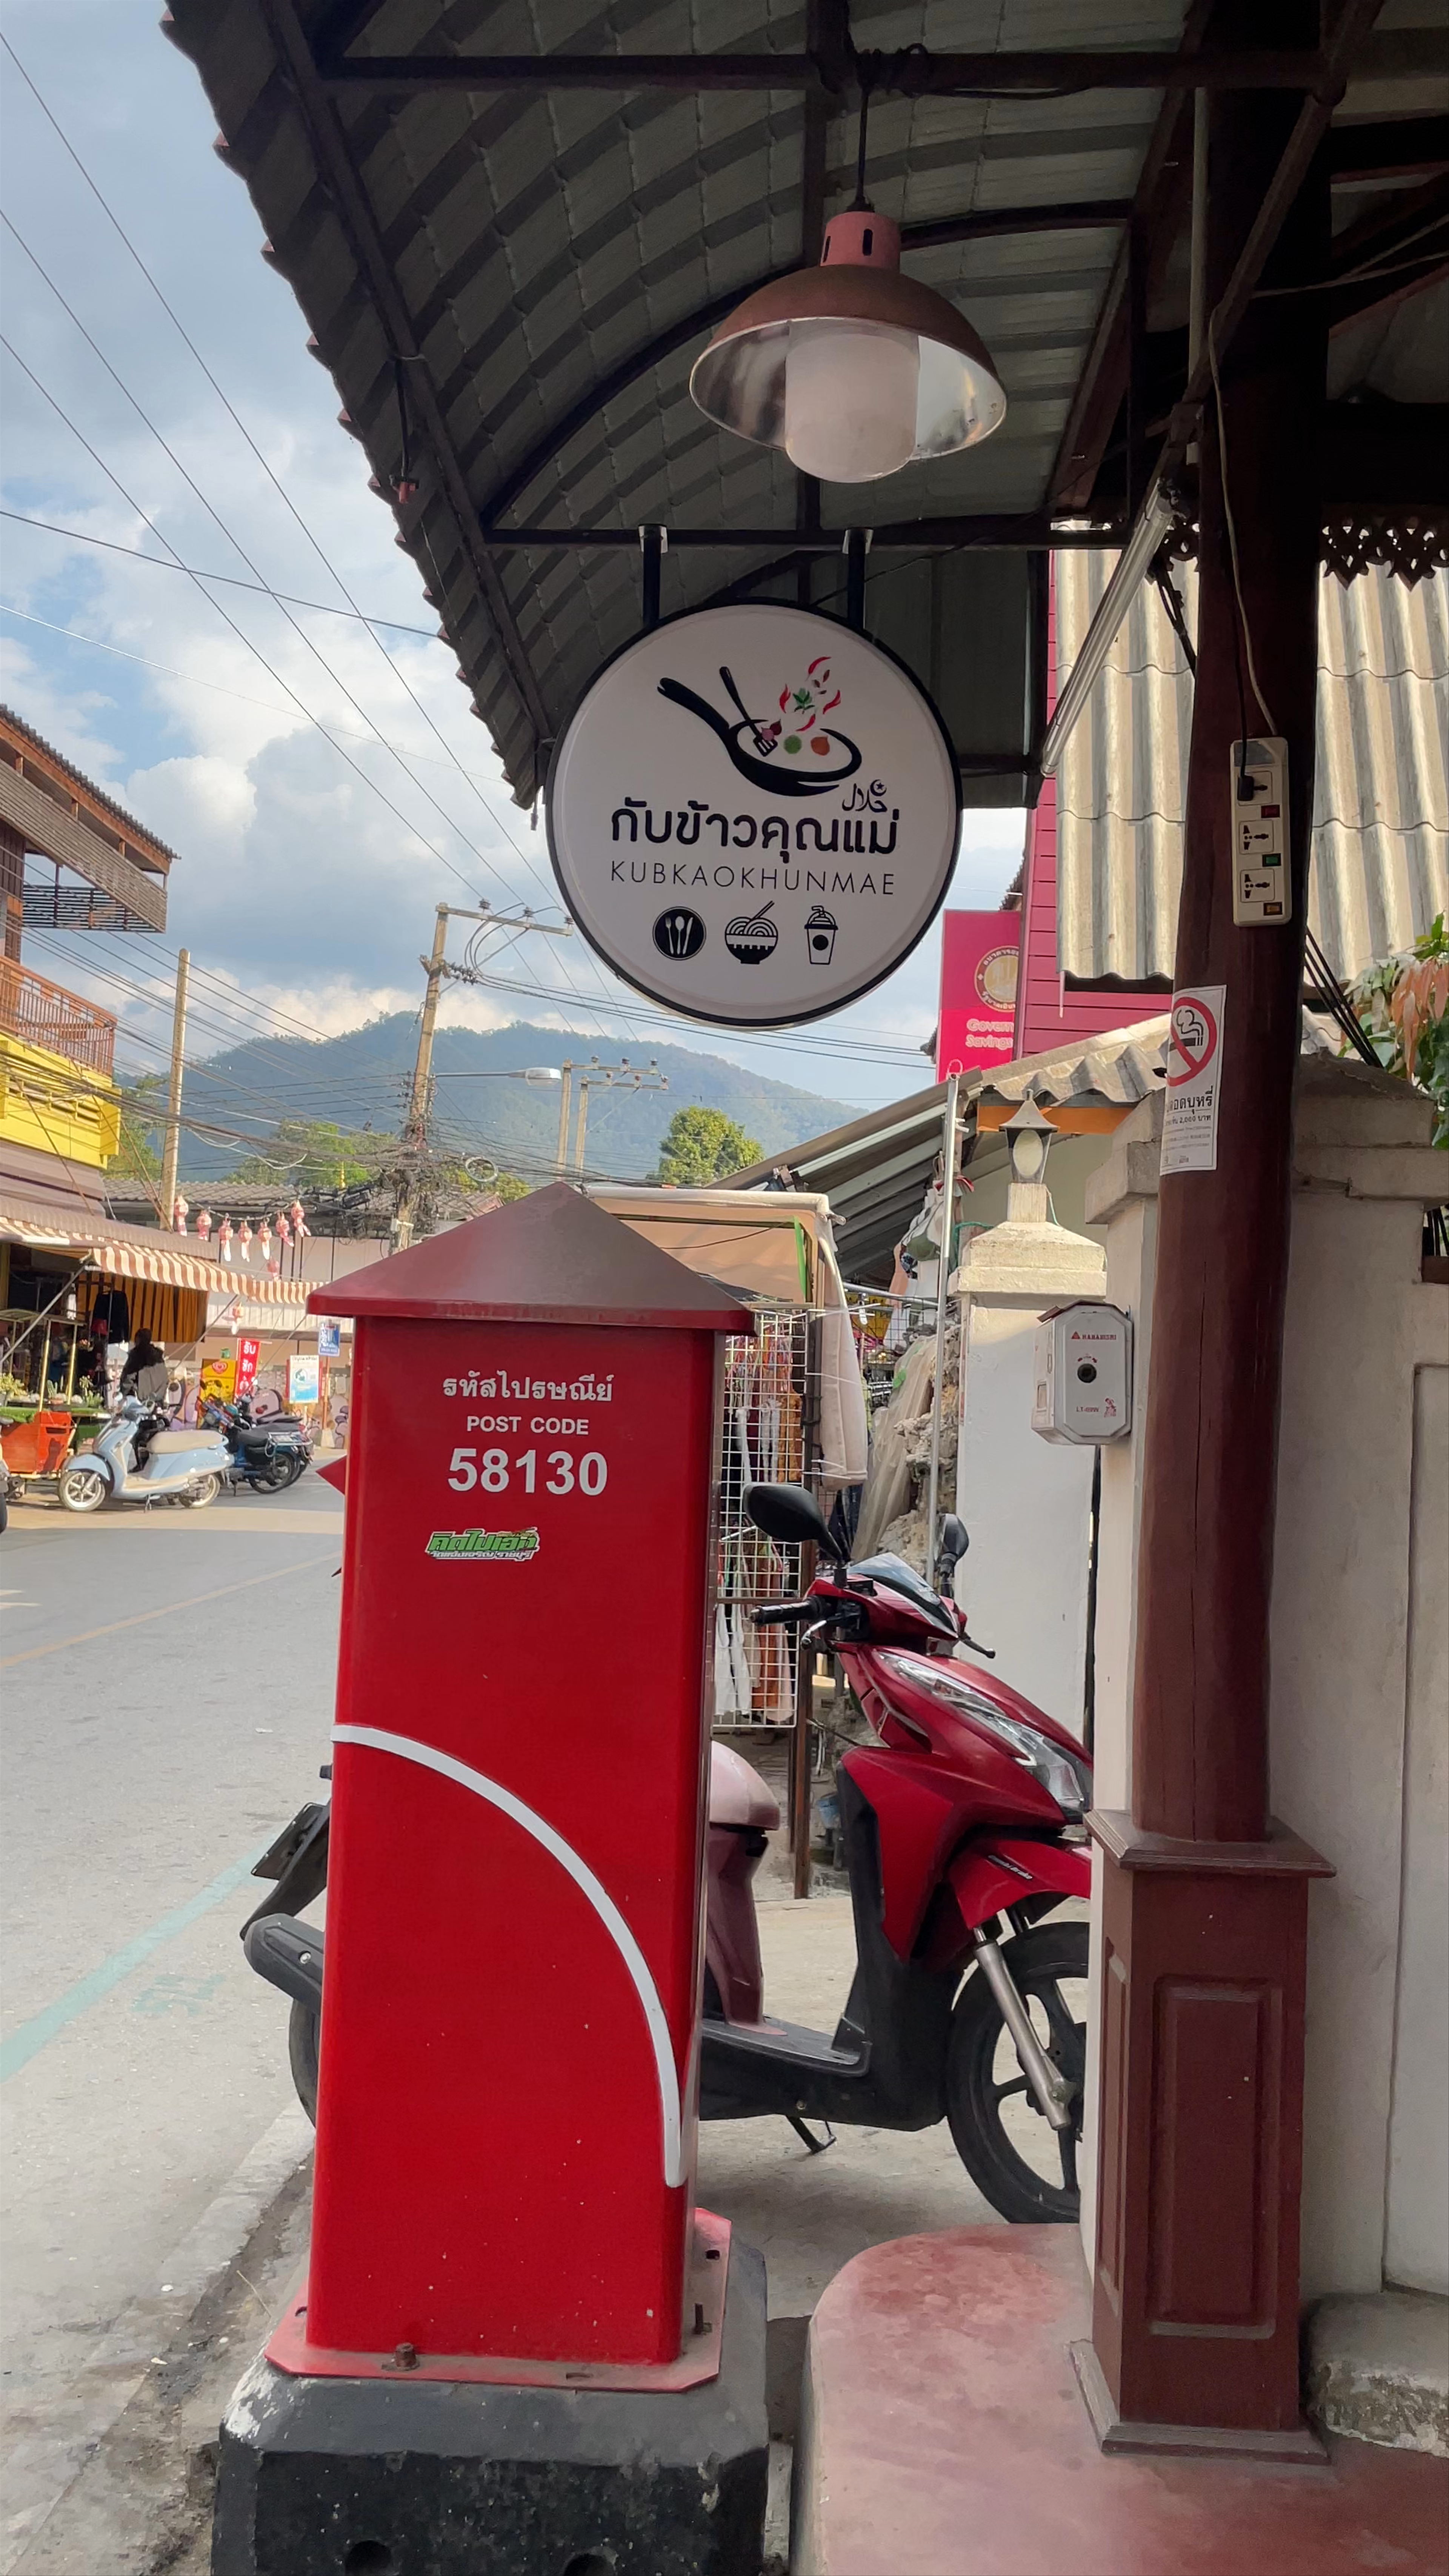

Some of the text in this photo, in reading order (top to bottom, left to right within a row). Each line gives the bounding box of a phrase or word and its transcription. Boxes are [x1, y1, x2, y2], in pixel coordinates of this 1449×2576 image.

[611, 797, 900, 863] กับข้าวคุณแม่
[611, 861, 895, 895] KUBKAOKHUNMAE
[443, 1370, 614, 1401] รหัสไปรษณีย์
[467, 1416, 589, 1435] POST CODE
[448, 1448, 608, 1496] 58130
